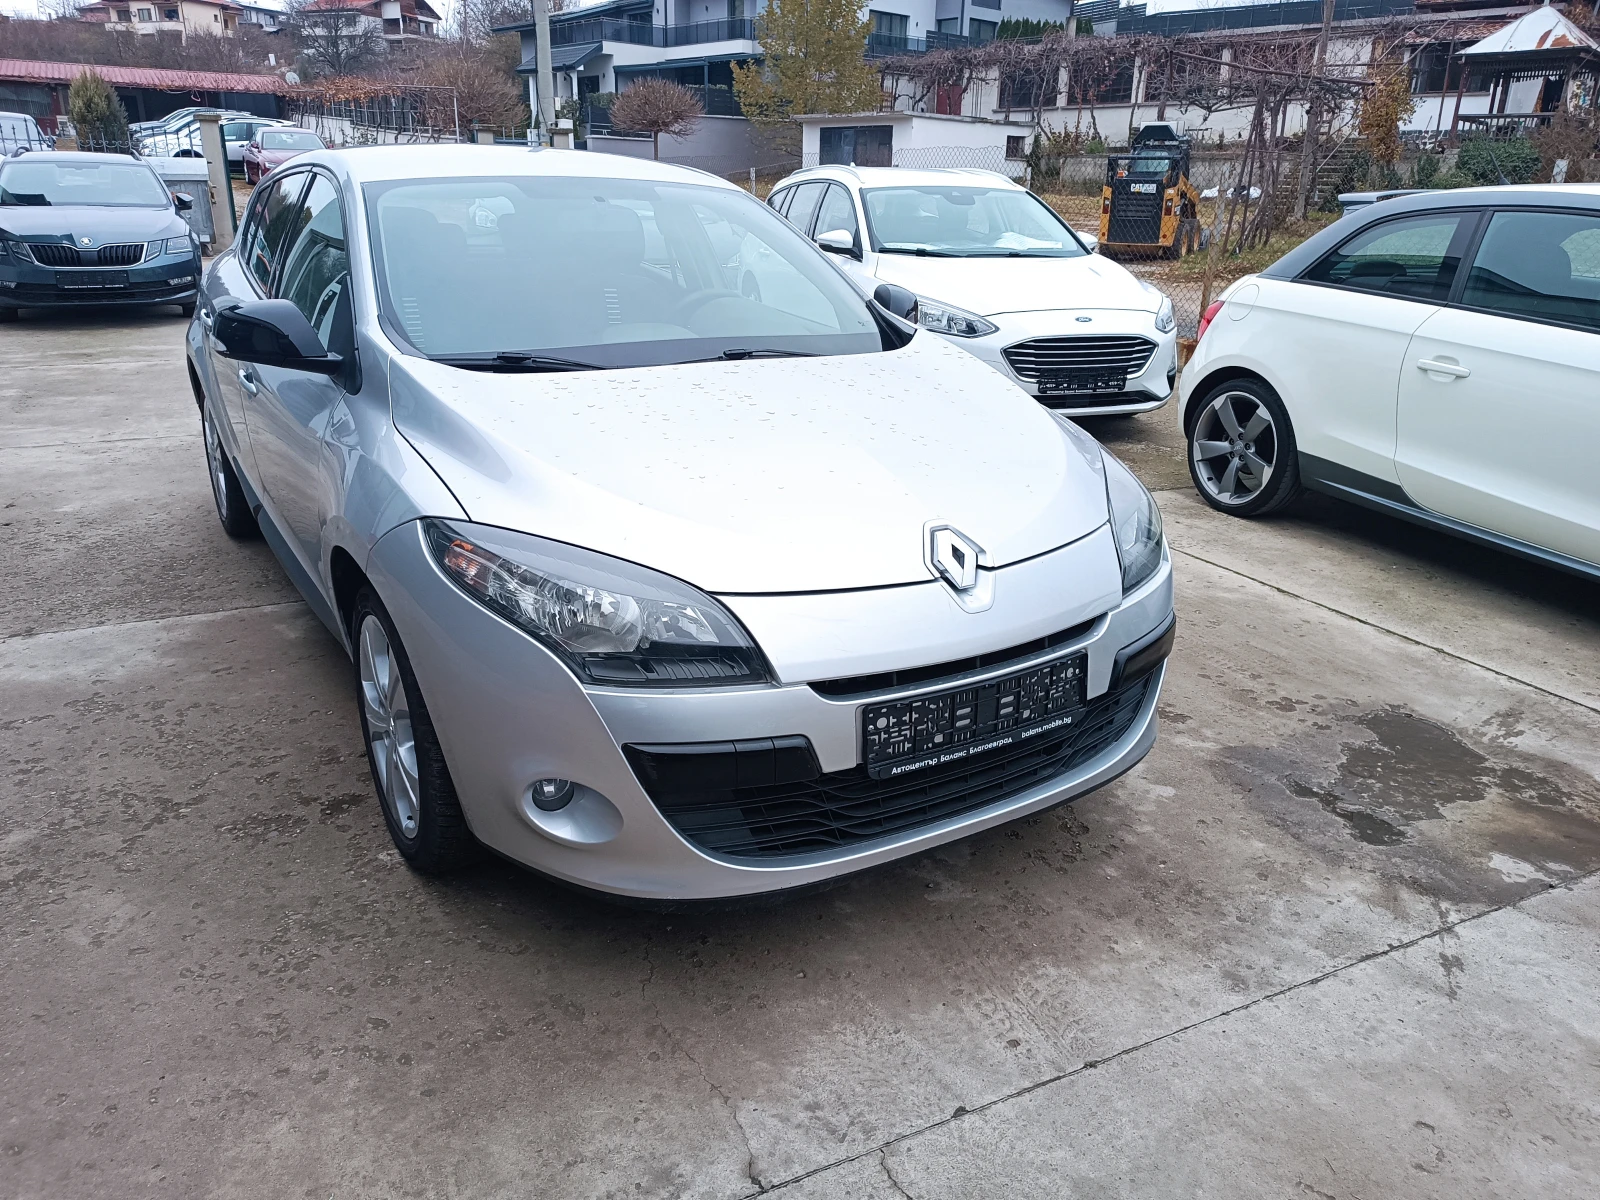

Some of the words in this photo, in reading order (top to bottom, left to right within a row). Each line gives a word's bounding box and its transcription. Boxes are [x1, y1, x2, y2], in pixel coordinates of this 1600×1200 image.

[1130, 183, 1143, 192] CAT
[1021, 716, 1072, 738] balans.mobile.bg
[891, 758, 938, 775] Автоцентър
[940, 750, 967, 762] Баланс
[969, 737, 1013, 754] Благоевград
